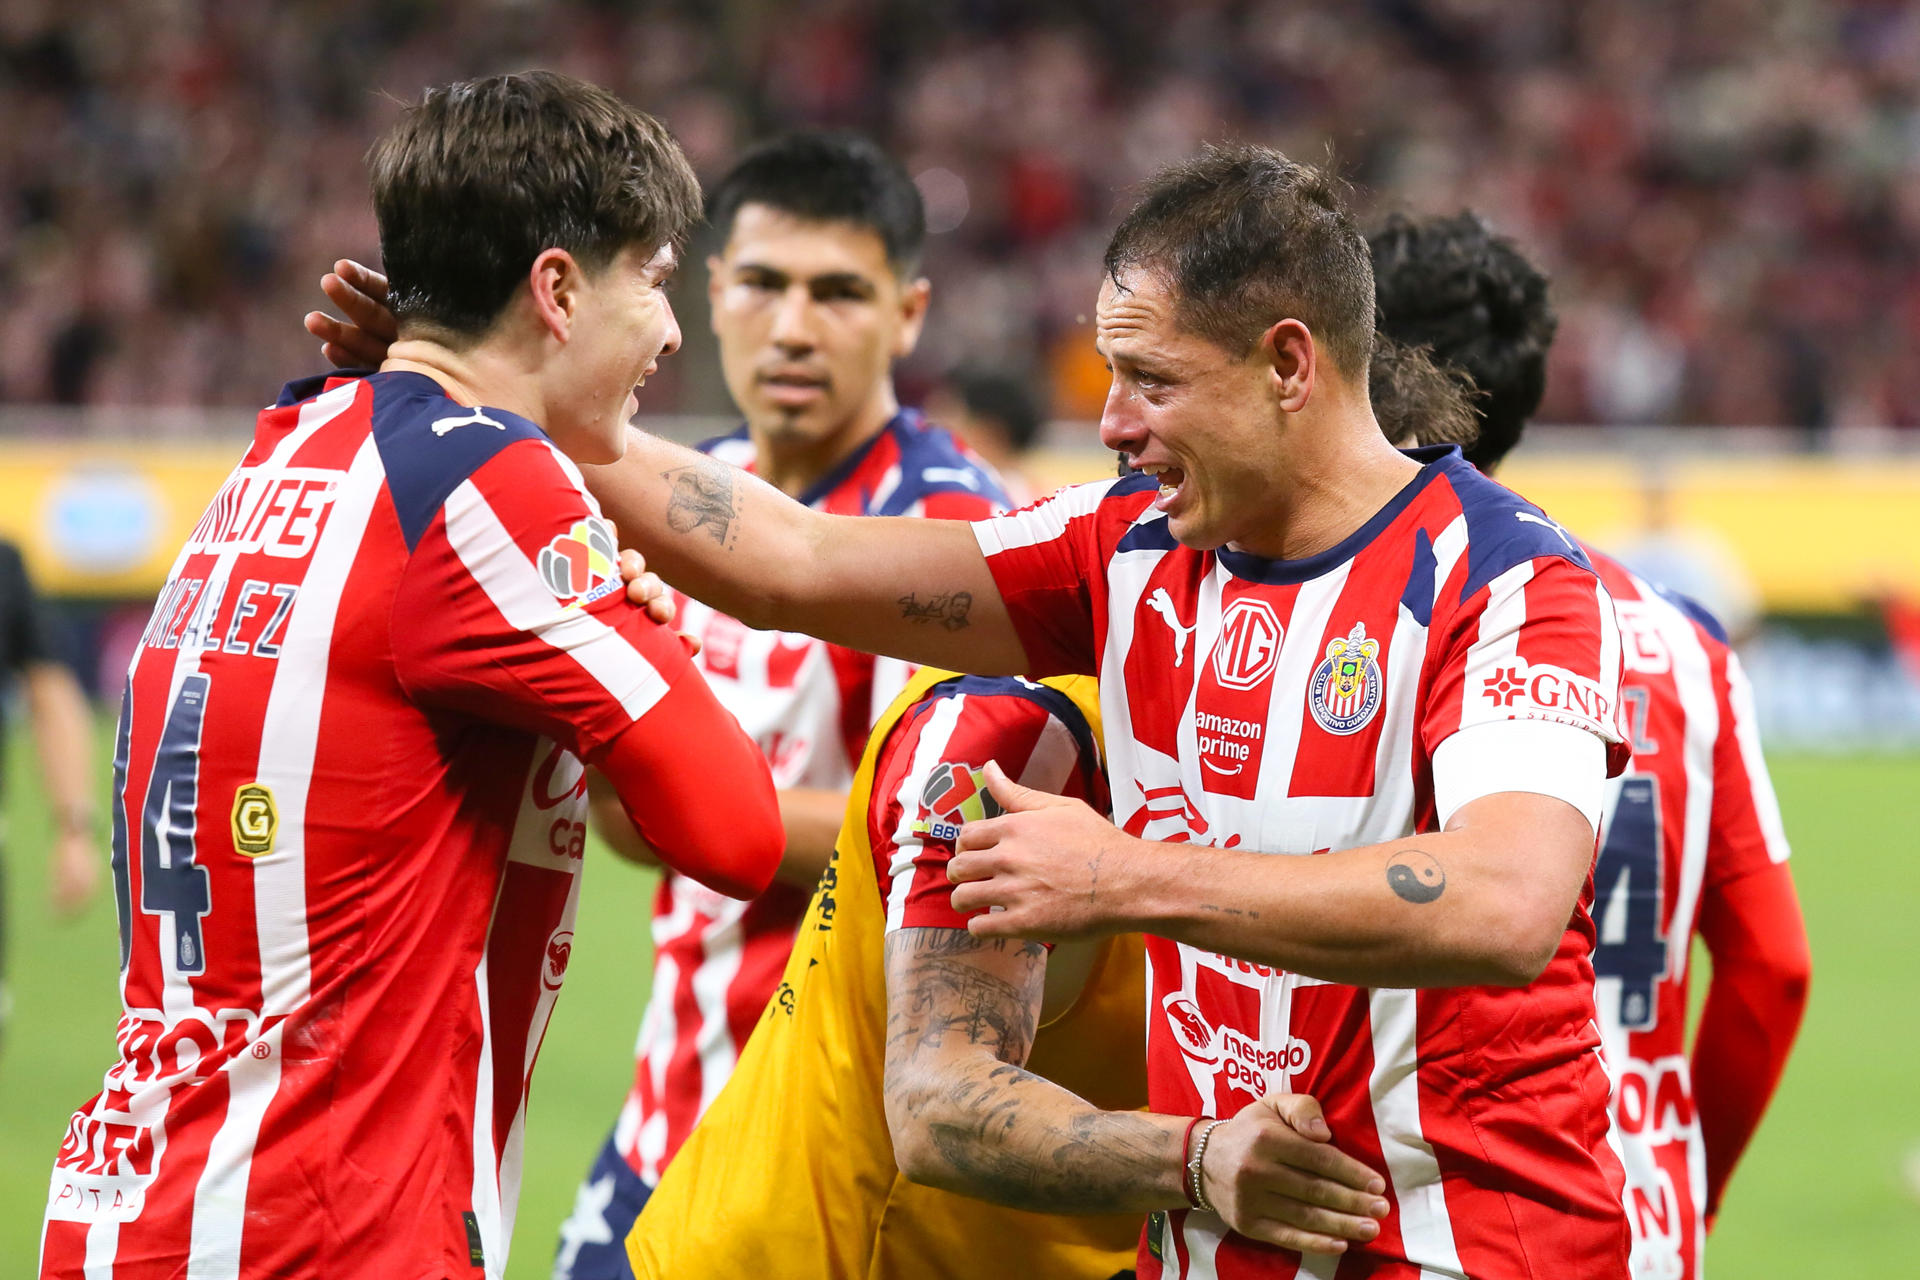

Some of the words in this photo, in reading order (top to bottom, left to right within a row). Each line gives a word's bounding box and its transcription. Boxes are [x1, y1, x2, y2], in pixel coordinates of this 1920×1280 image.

[142, 578, 301, 658] ONZALEZ
[1222, 608, 1274, 680] MG
[1314, 672, 1327, 695] CLUB
[1346, 674, 1377, 728] GUADALAJARA
[1530, 673, 1608, 724] GNP
[1196, 711, 1262, 740] amazon
[1315, 697, 1346, 729] DEPORTIVO
[1199, 735, 1250, 761] prime
